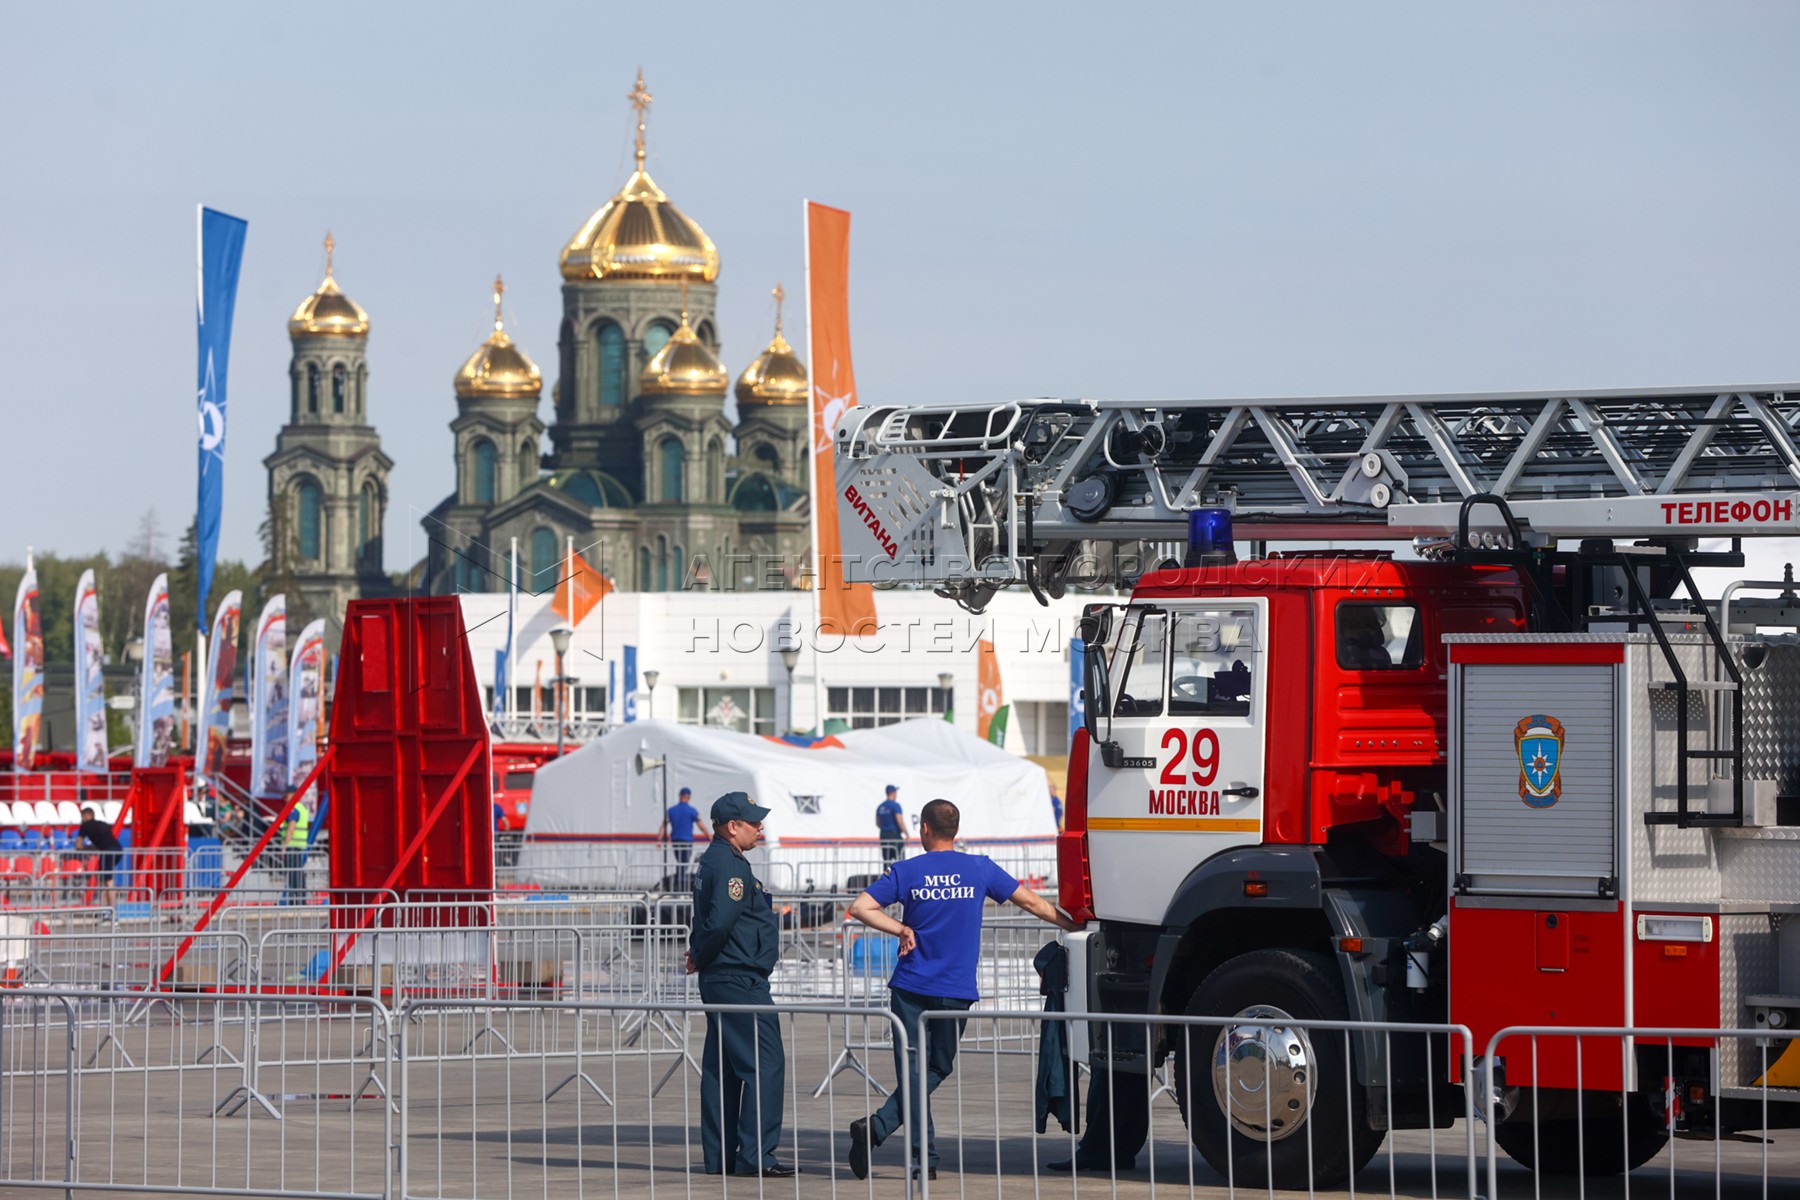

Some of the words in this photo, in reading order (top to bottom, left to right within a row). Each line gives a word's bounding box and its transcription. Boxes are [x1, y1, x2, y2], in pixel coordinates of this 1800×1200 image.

[1661, 500, 1791, 524] ТЕЛЕФОН
[1160, 728, 1220, 787] 29
[1149, 790, 1220, 815] МОСКВА
[924, 874, 961, 887] МЧС
[911, 887, 975, 900] РОССИИ
